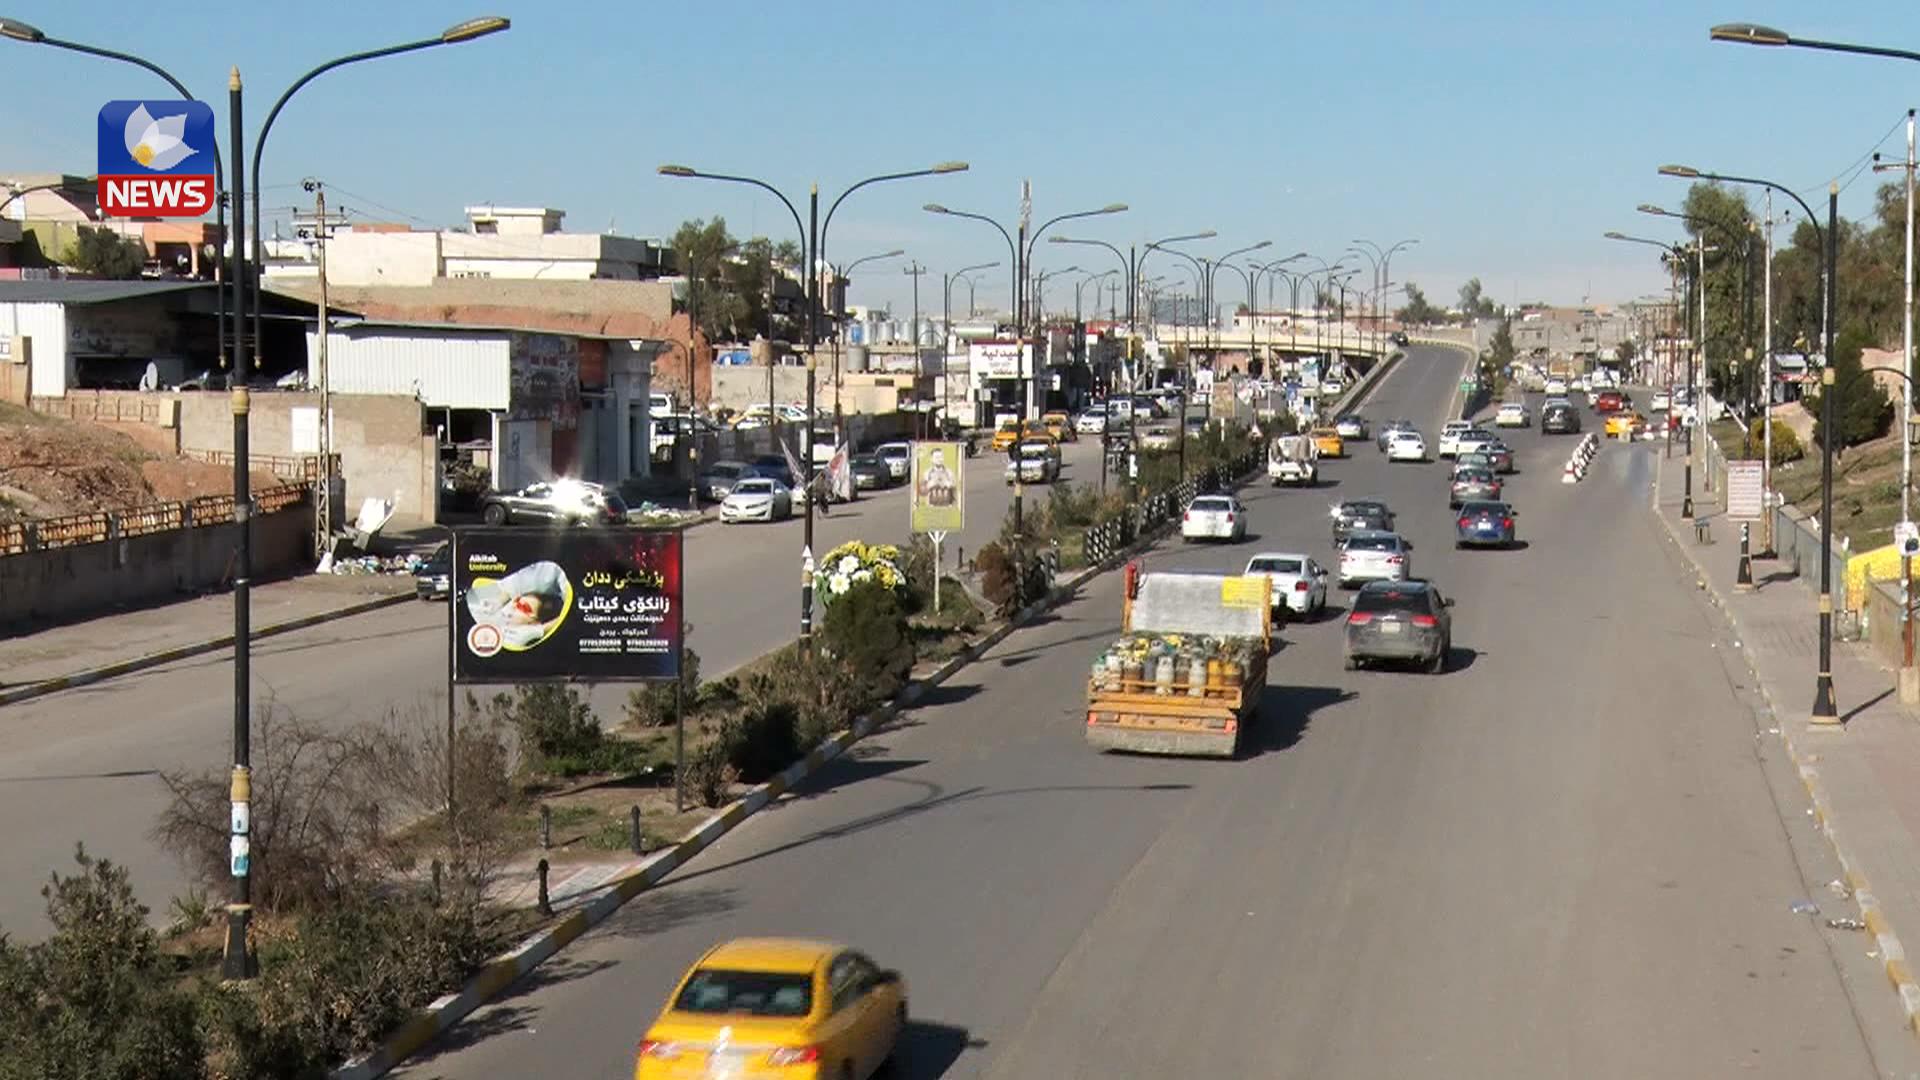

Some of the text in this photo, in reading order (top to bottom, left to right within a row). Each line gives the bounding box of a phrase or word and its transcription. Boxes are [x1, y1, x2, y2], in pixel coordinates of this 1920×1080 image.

[469, 554, 498, 563] Alkitab
[469, 562, 507, 572] University
[582, 570, 611, 587] ددان
